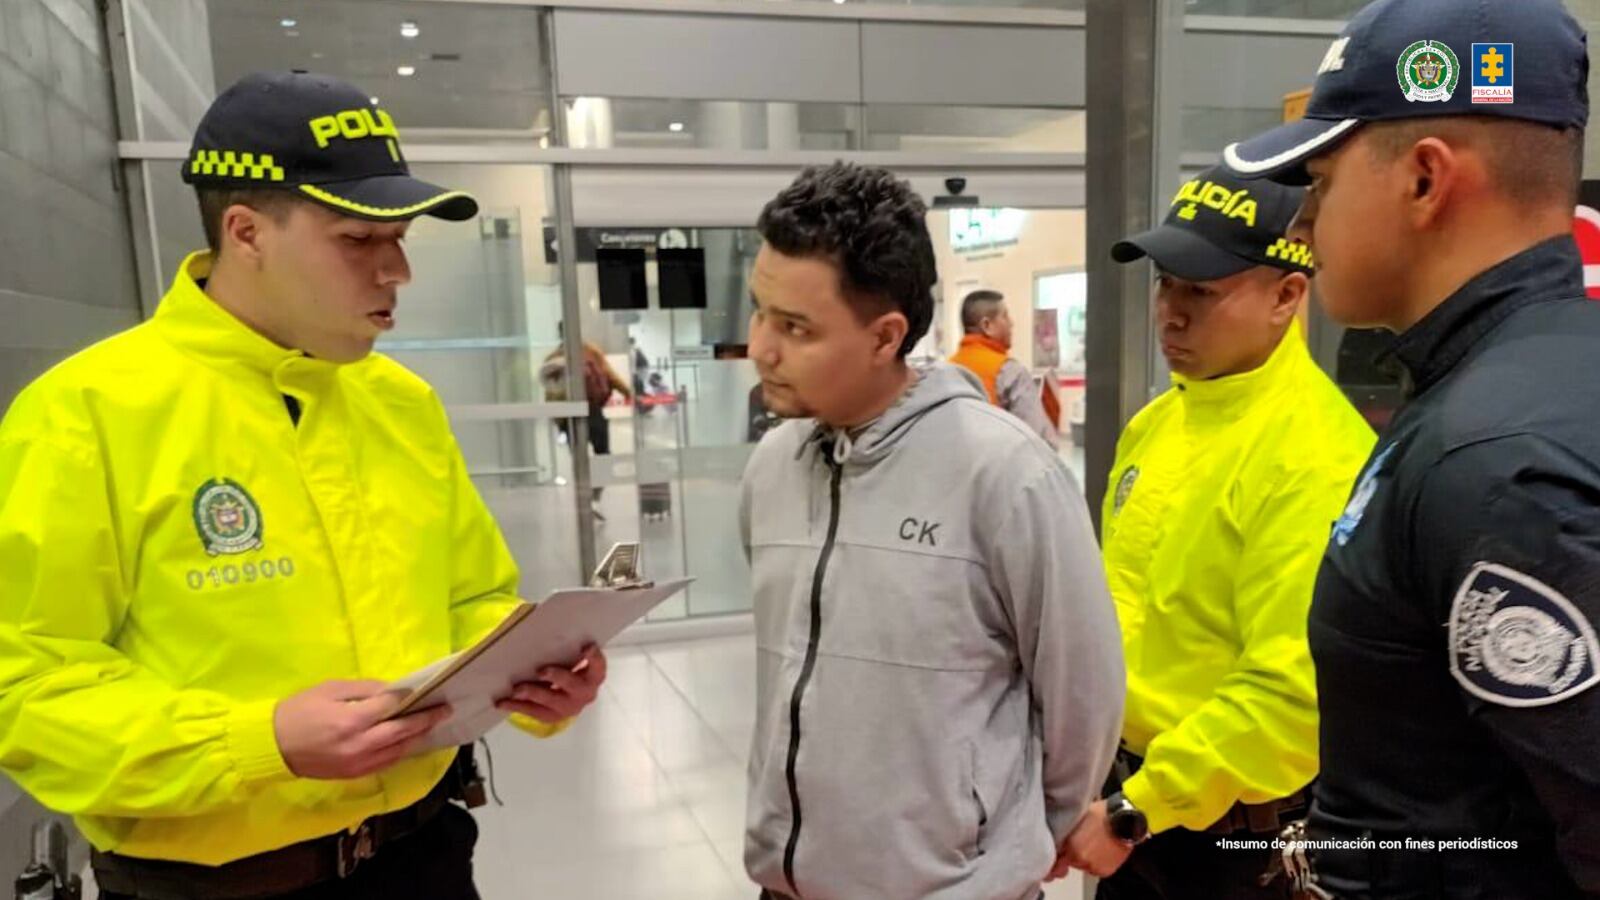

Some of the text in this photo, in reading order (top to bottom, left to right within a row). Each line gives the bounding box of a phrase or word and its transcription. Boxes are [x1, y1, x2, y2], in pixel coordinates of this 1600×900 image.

[309, 108, 400, 149] POLI
[899, 516, 942, 547] CK
[186, 556, 295, 591] 010900
